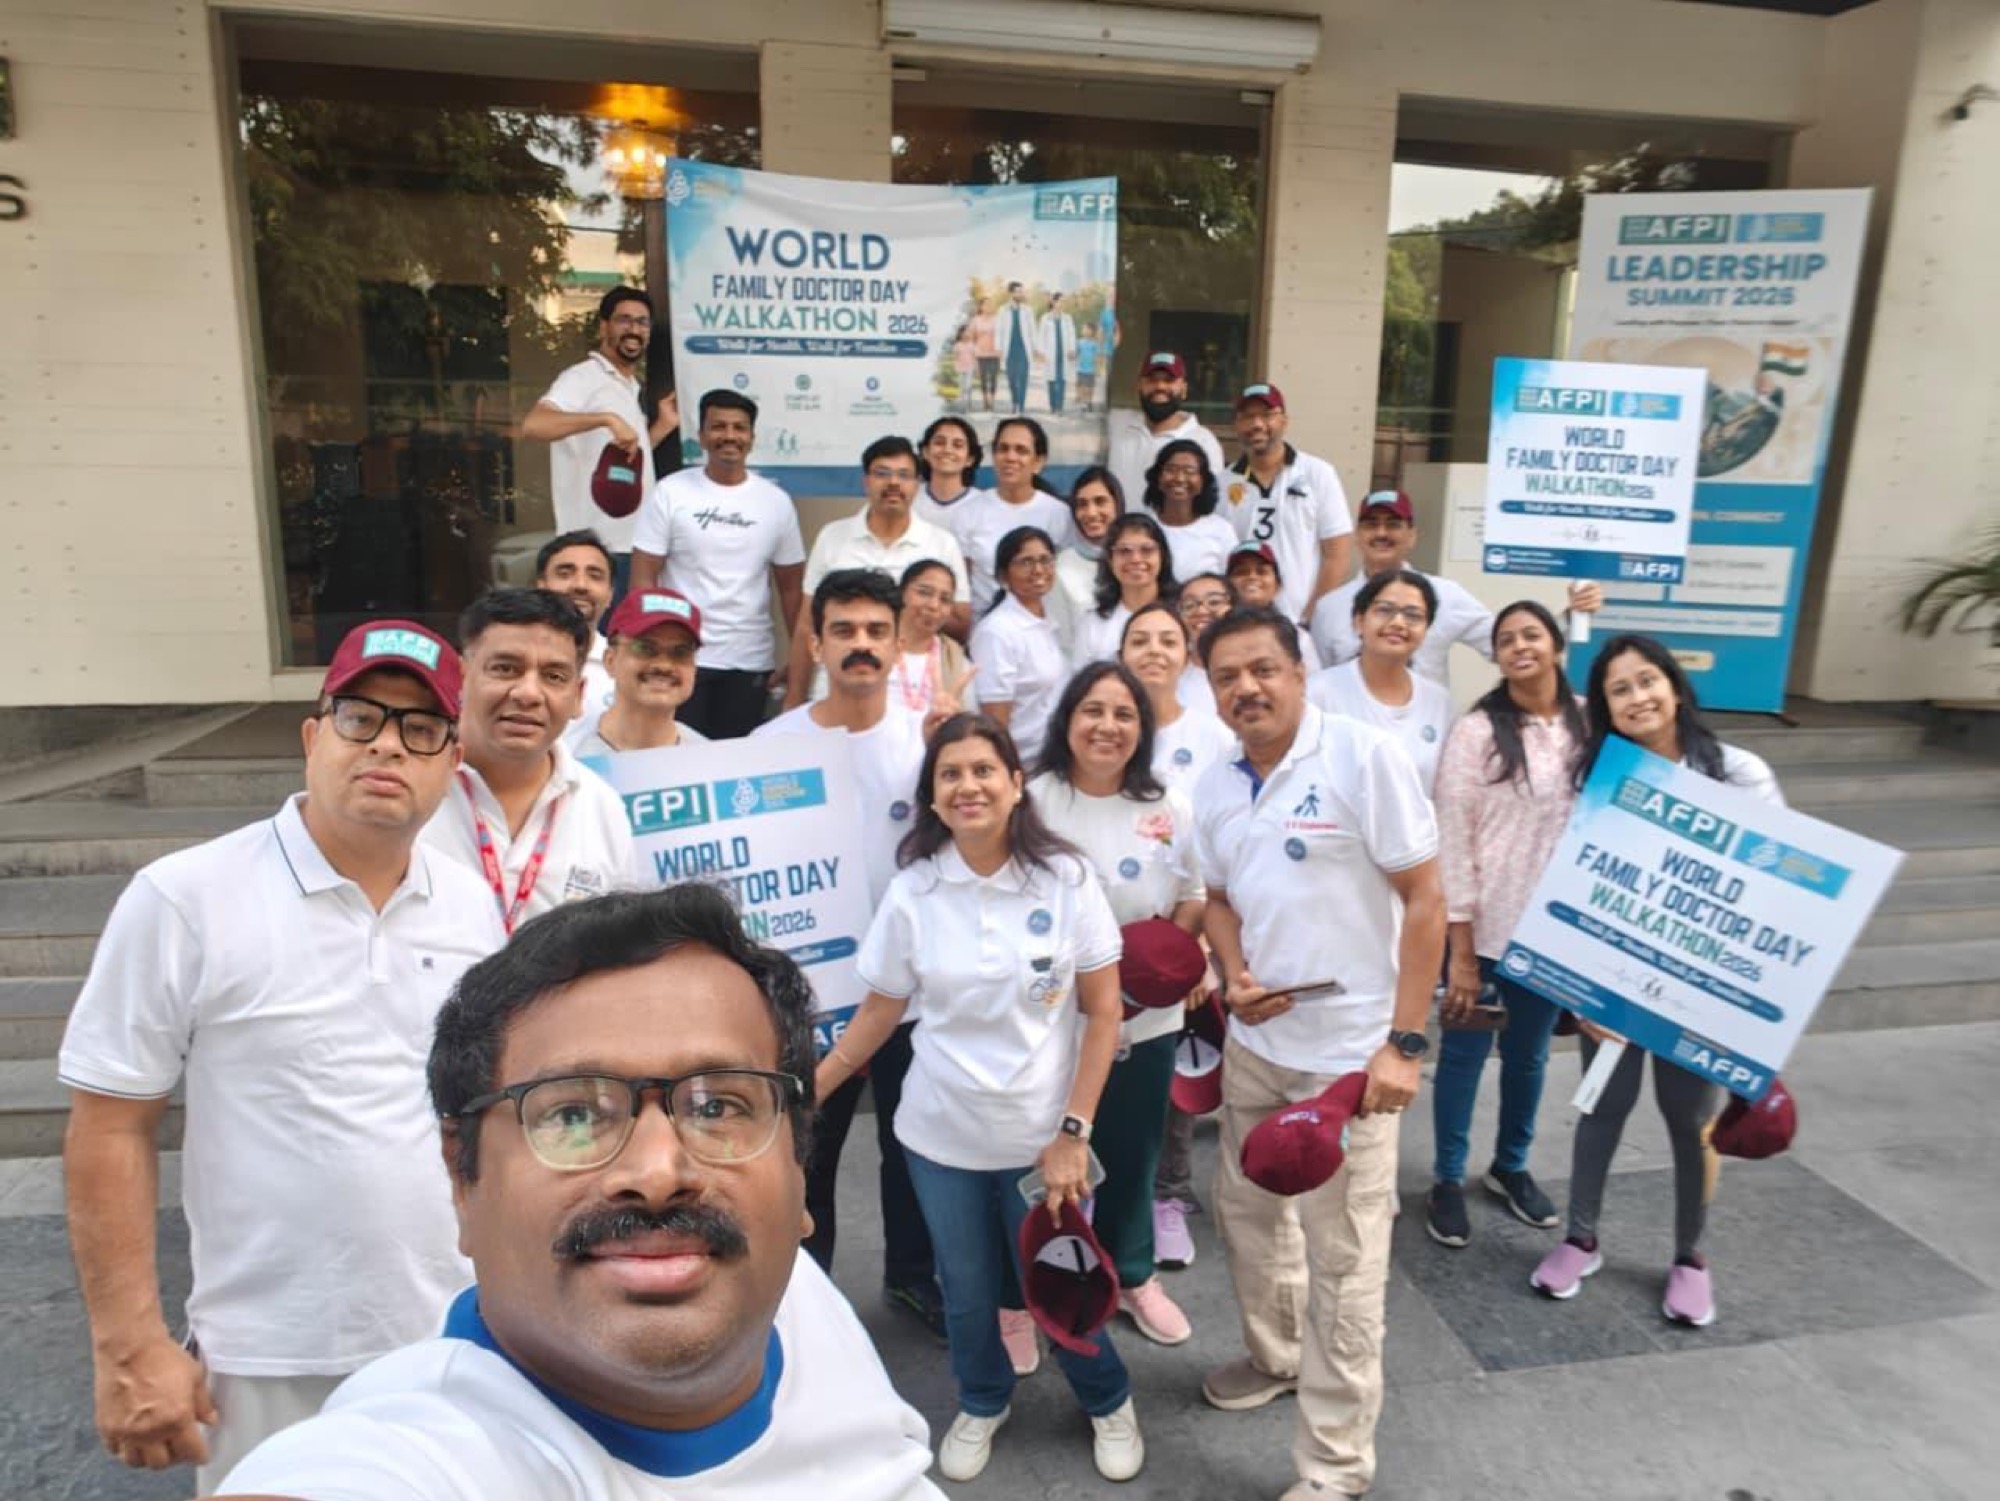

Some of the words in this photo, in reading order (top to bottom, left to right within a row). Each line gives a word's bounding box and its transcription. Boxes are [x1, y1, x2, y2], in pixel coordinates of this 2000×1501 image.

[1647, 216, 1725, 238] AFPI
[725, 226, 890, 271] WORLD
[1607, 253, 1827, 281] LEADERSHIP
[713, 275, 787, 300] FAMILY
[793, 277, 864, 301] DOCTOR
[869, 280, 910, 303] DAY
[1628, 287, 1728, 305] SUMMIT
[694, 302, 877, 331] WALKATHON
[888, 315, 928, 335] 2026
[1537, 388, 1602, 410] AFPI
[1565, 426, 1625, 449] WORLD
[1506, 447, 1571, 470] FAMILY
[1575, 452, 1638, 475] DOCTOR
[1642, 455, 1679, 477] DAY
[1525, 473, 1626, 498] WALKATHON
[1254, 507, 1276, 540] 3
[1632, 562, 1680, 579] AFPI
[632, 786, 701, 826] FPI
[1641, 791, 1731, 848] AFPI
[654, 836, 750, 883] WORLD
[787, 856, 840, 895] DAY
[1661, 847, 1745, 904] WORLD
[1575, 842, 1664, 899] FAMILY
[1662, 885, 1753, 943] DOCTOR
[1752, 925, 1816, 967] DAY
[770, 908, 817, 937] 2026
[1588, 881, 1725, 965] WALKATHON
[1690, 1049, 1763, 1091] AFPI
